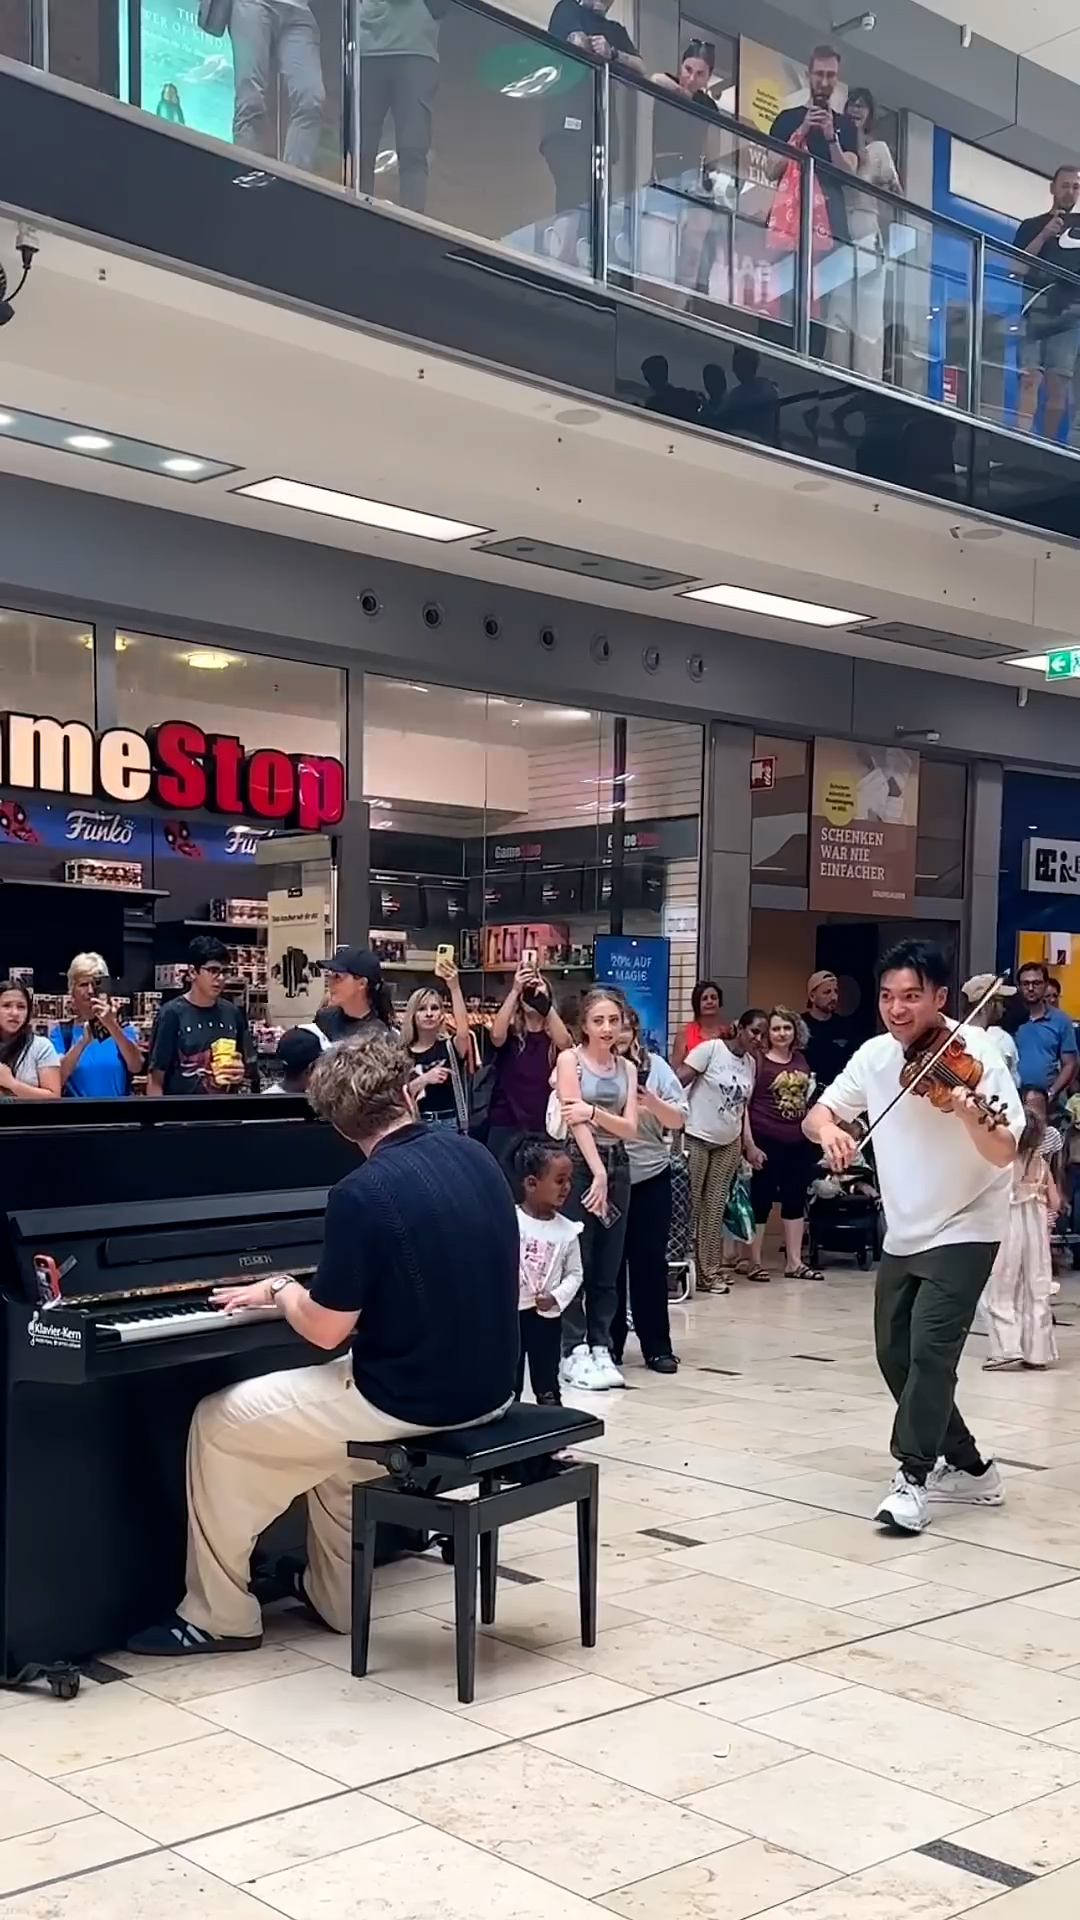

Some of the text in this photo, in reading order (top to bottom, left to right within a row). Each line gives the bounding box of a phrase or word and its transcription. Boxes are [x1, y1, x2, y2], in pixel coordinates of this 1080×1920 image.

[0, 714, 344, 831] meStop
[65, 810, 137, 845] Funko
[821, 826, 884, 847] SCHENKEN
[820, 844, 870, 862] WAR NIE
[820, 862, 885, 881] EINFACHER
[633, 956, 653, 969] AUF
